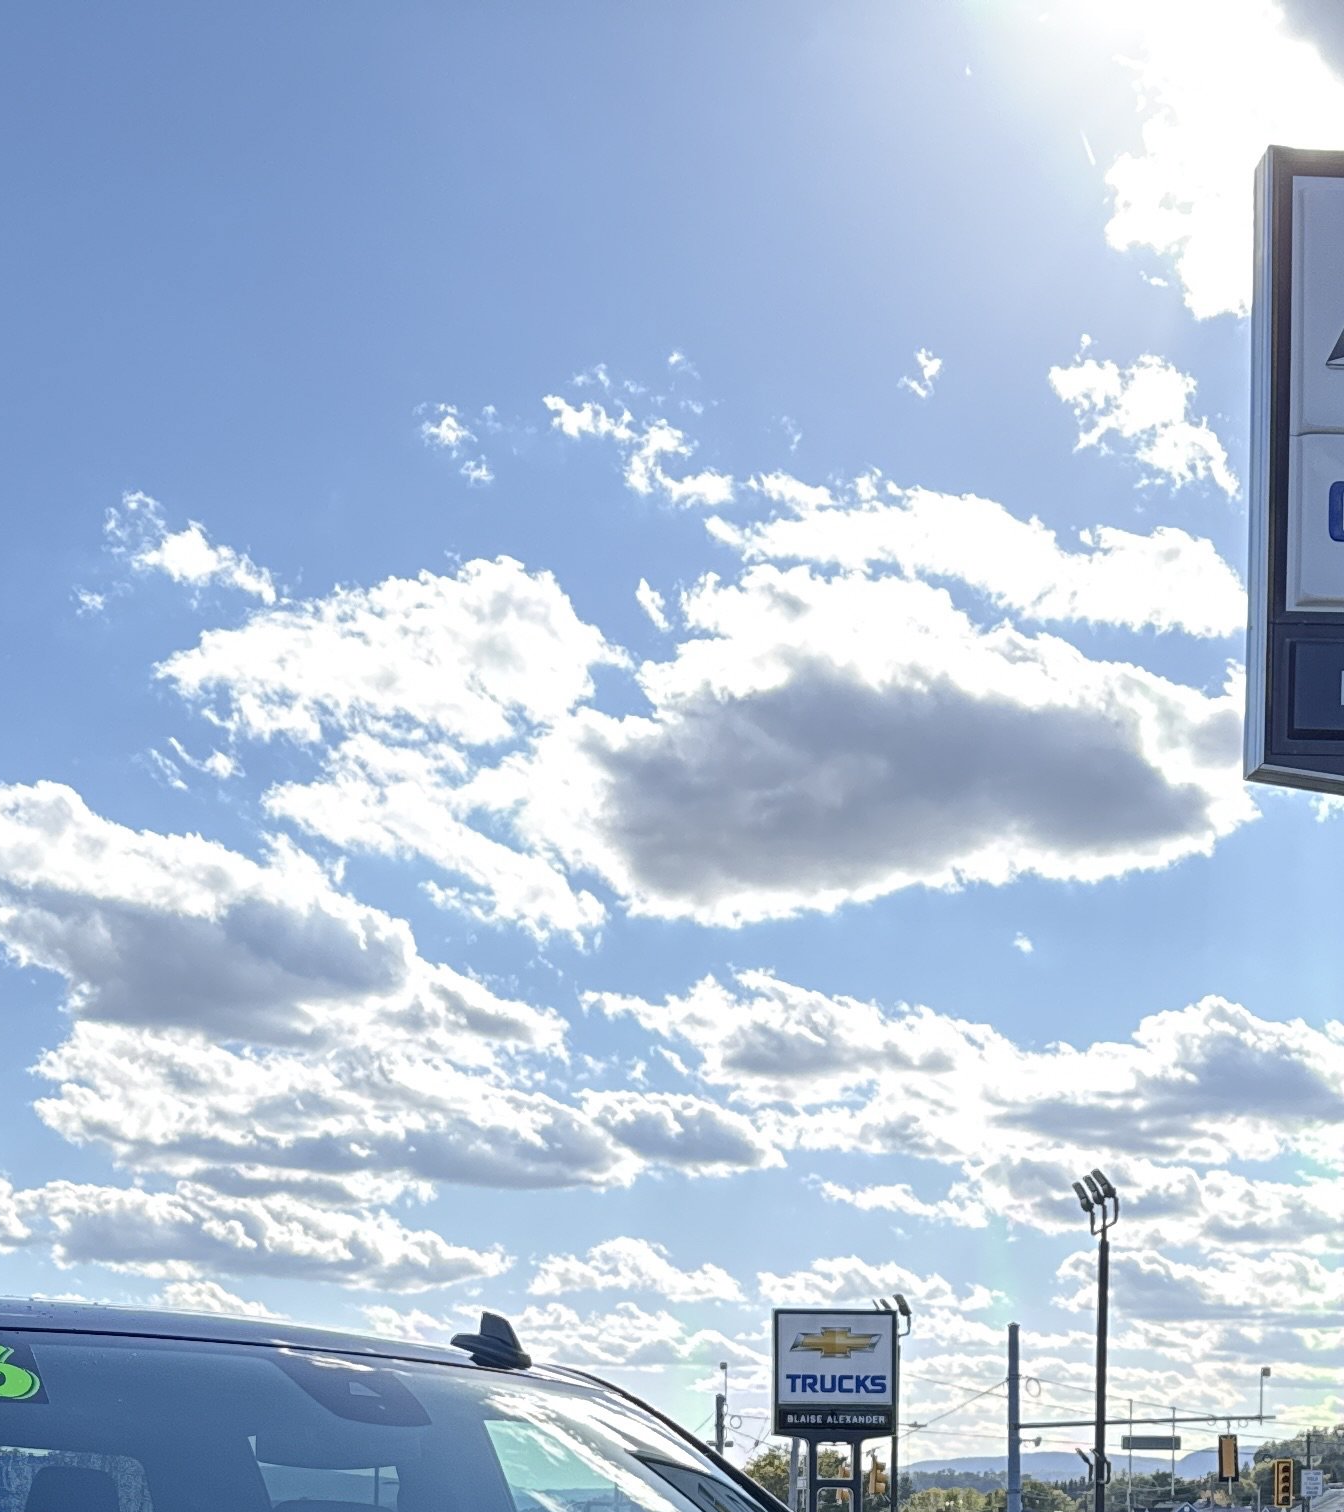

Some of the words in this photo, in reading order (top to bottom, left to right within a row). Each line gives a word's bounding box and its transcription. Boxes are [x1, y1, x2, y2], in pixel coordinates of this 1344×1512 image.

[785, 1374, 887, 1394] TRUCKS
[787, 1414, 823, 1424] BLAISE
[826, 1415, 885, 1424] ALEXANDER
